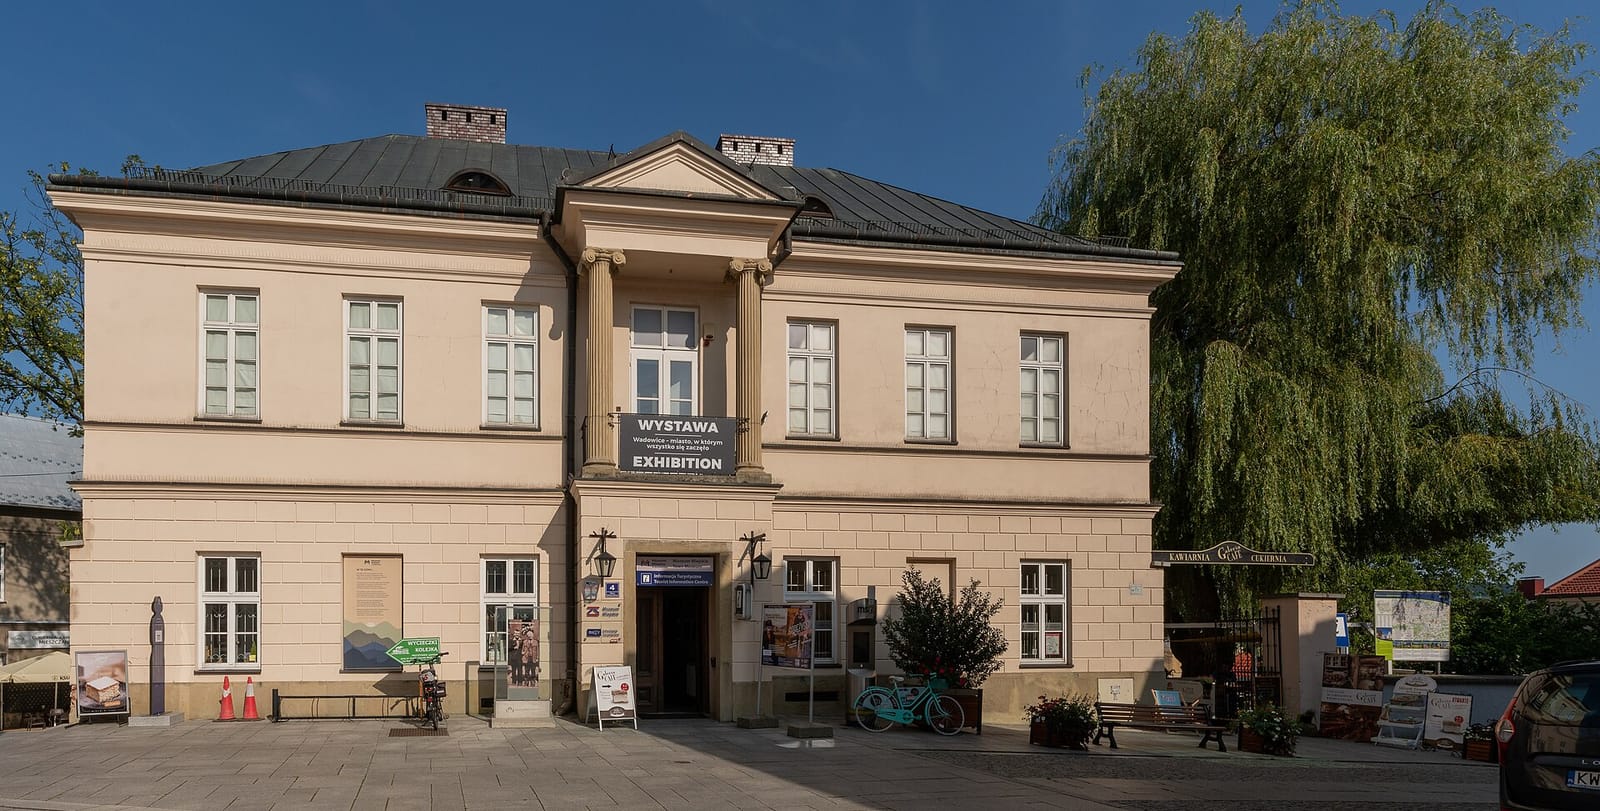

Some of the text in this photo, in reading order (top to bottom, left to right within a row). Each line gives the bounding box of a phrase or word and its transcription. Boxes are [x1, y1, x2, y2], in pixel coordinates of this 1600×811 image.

[638, 419, 719, 433] WYSTAWA
[632, 436, 665, 444] Wadowice
[633, 456, 722, 470] EXHIBITION
[1169, 553, 1210, 561] KAWIARNIA
[1251, 554, 1287, 562] CUKIERNIA
[1577, 772, 1600, 786] KW
